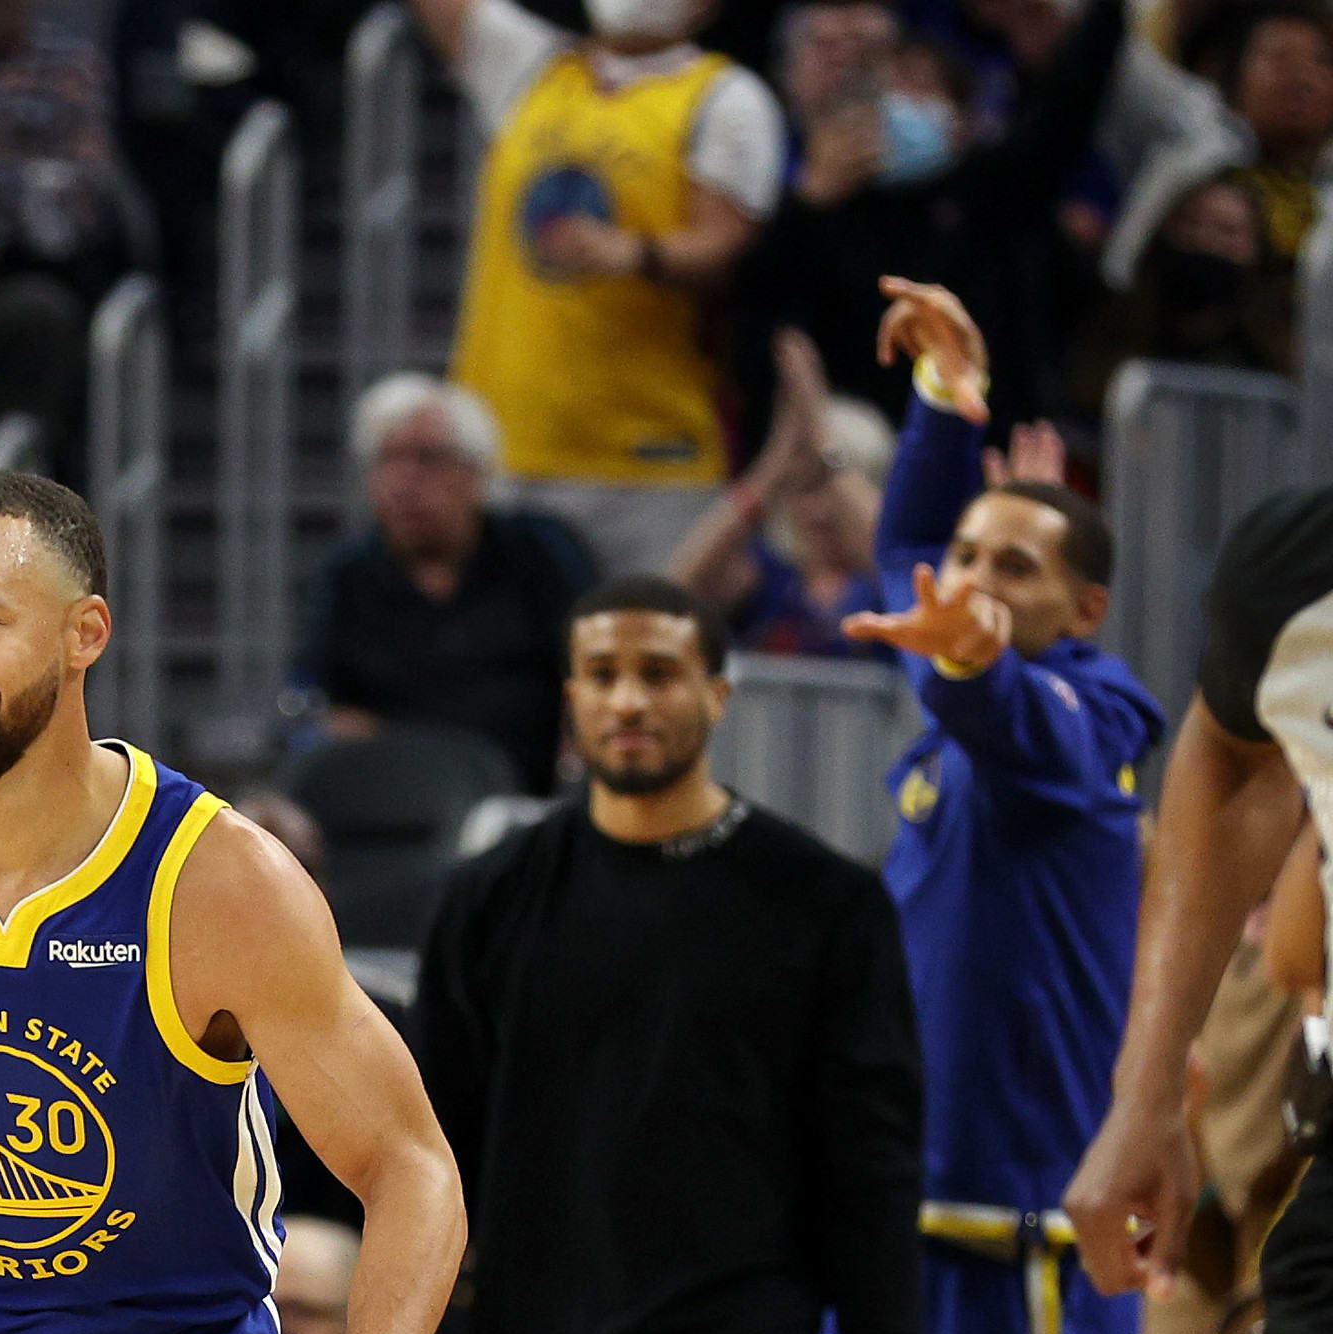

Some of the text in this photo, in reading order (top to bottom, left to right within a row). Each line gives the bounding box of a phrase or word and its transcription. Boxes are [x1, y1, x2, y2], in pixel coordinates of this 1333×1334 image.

[48, 939, 141, 962] Rakuten
[24, 1017, 118, 1094] STATE
[4, 1092, 87, 1155] 30
